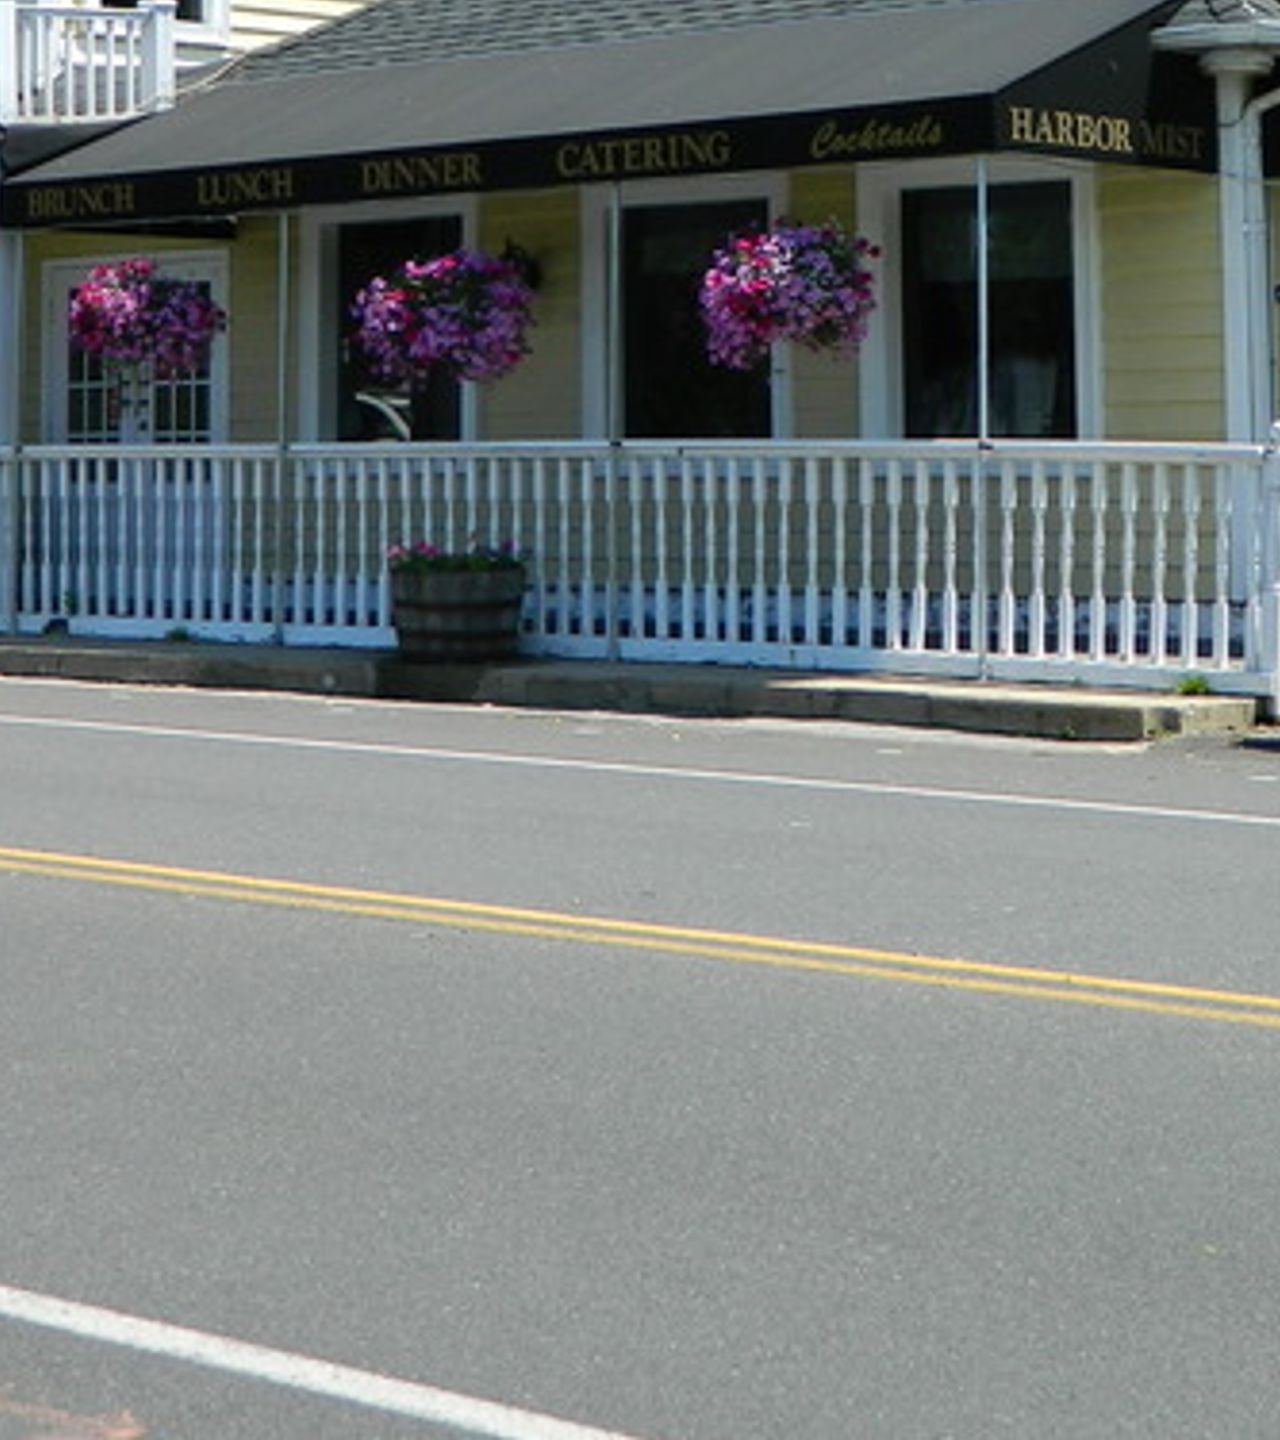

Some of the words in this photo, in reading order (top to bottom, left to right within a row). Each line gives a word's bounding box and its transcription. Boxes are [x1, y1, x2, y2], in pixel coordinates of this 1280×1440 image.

[28, 184, 134, 216] BRUNCH
[197, 169, 293, 203] LUNCH
[362, 154, 481, 192] DINNER
[557, 133, 731, 177] CATERING
[811, 115, 941, 158] Cocktails
[1010, 108, 1133, 152] HARBOR
[1141, 121, 1203, 158] MIST
